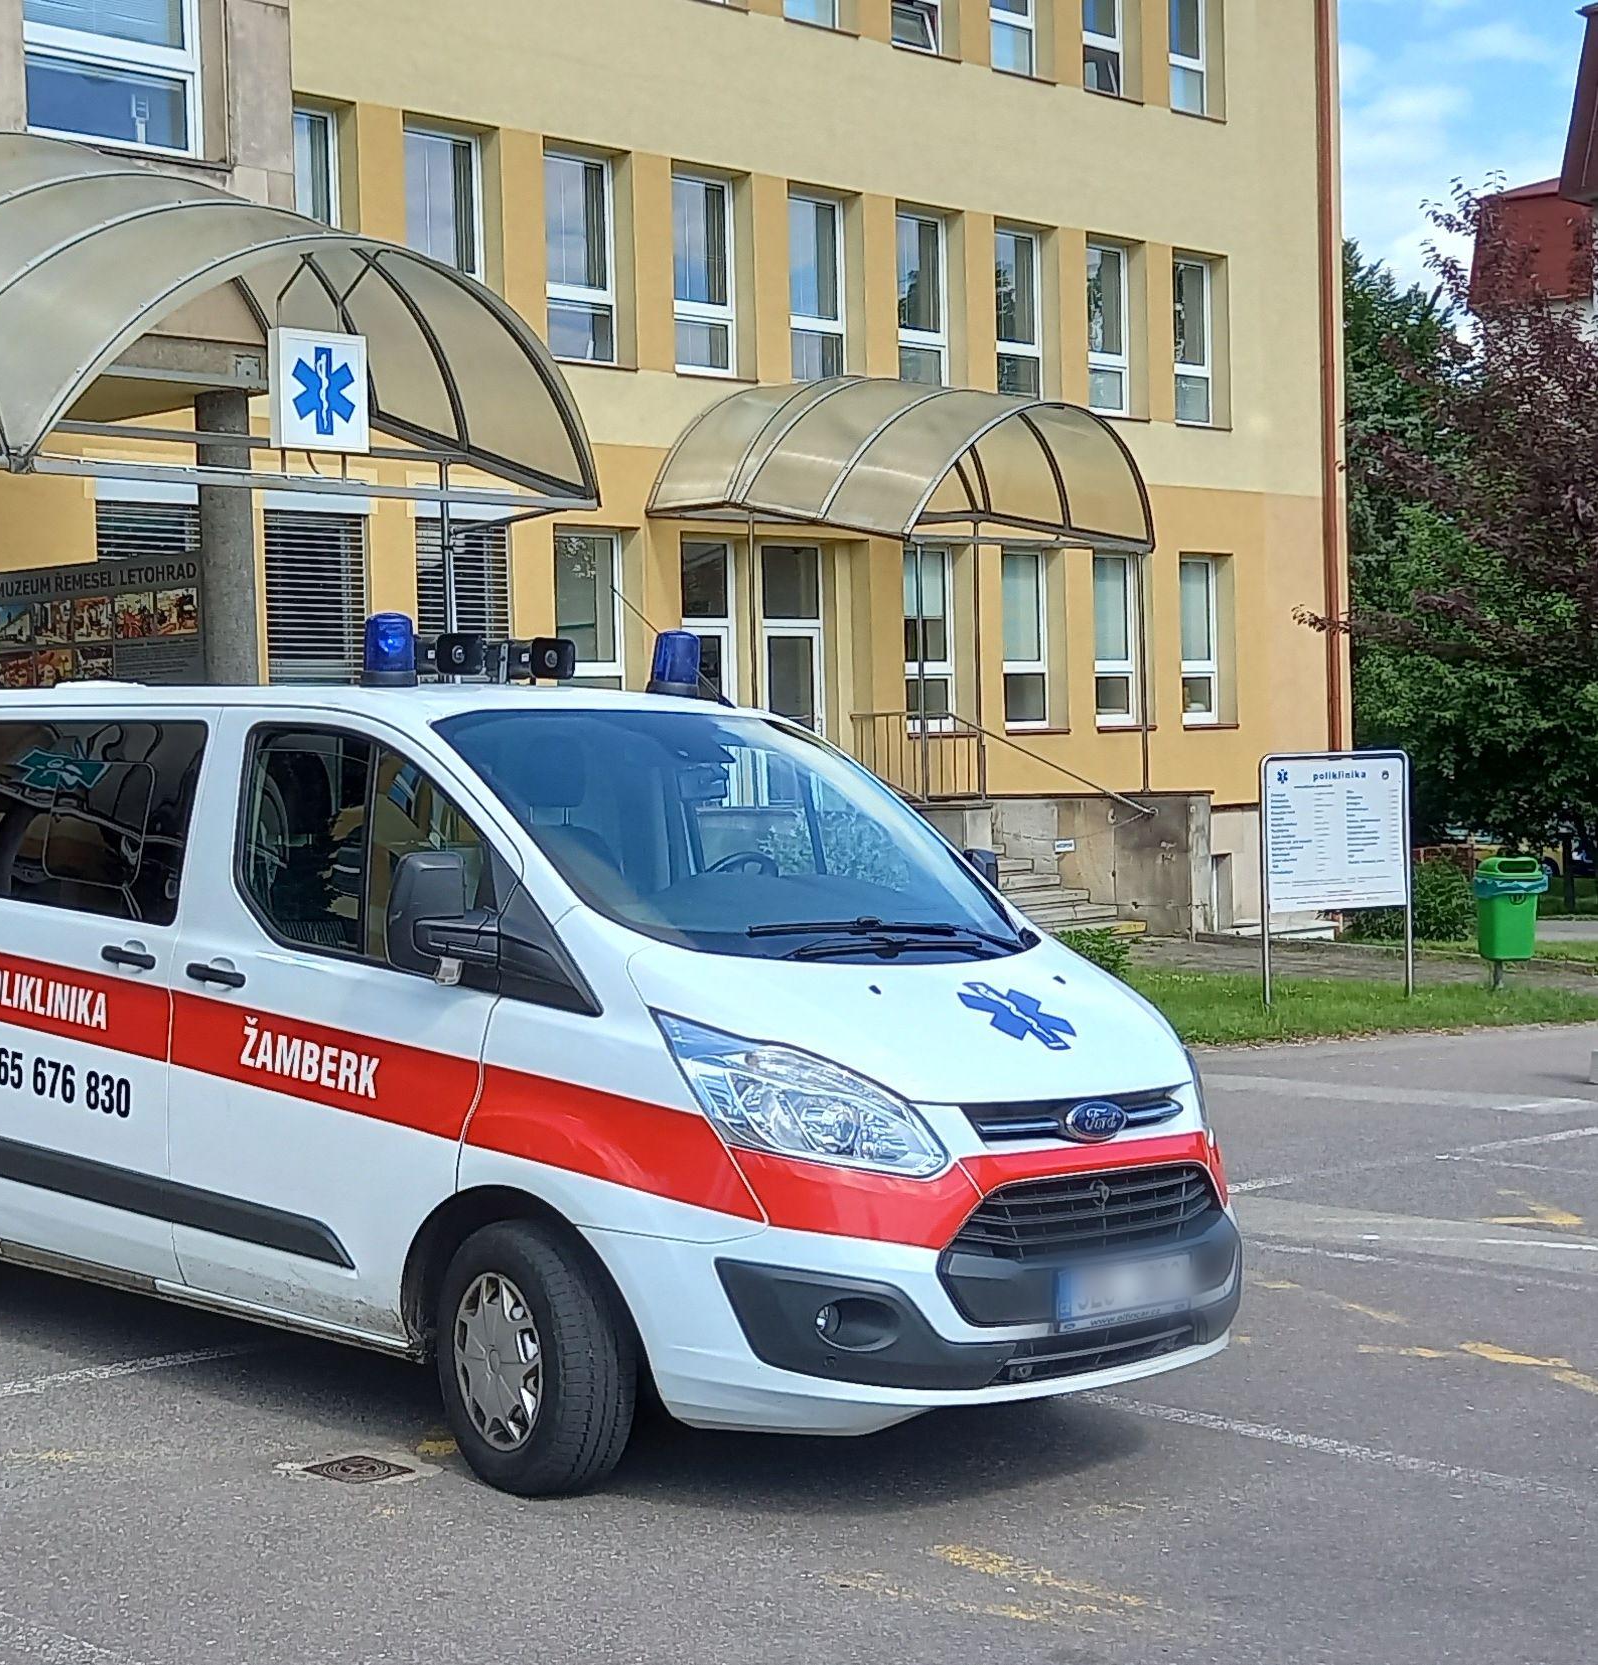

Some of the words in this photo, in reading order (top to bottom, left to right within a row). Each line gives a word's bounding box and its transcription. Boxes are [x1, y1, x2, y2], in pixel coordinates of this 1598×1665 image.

[54, 570, 116, 593] ŘEMESEL
[120, 562, 197, 587] LETOHRAD
[1312, 770, 1367, 782] poliklinika
[240, 1015, 380, 1100] ŽAMBERK
[32, 1055, 76, 1105] 676
[85, 1070, 132, 1119] 830
[1084, 1107, 1119, 1131] Ford
